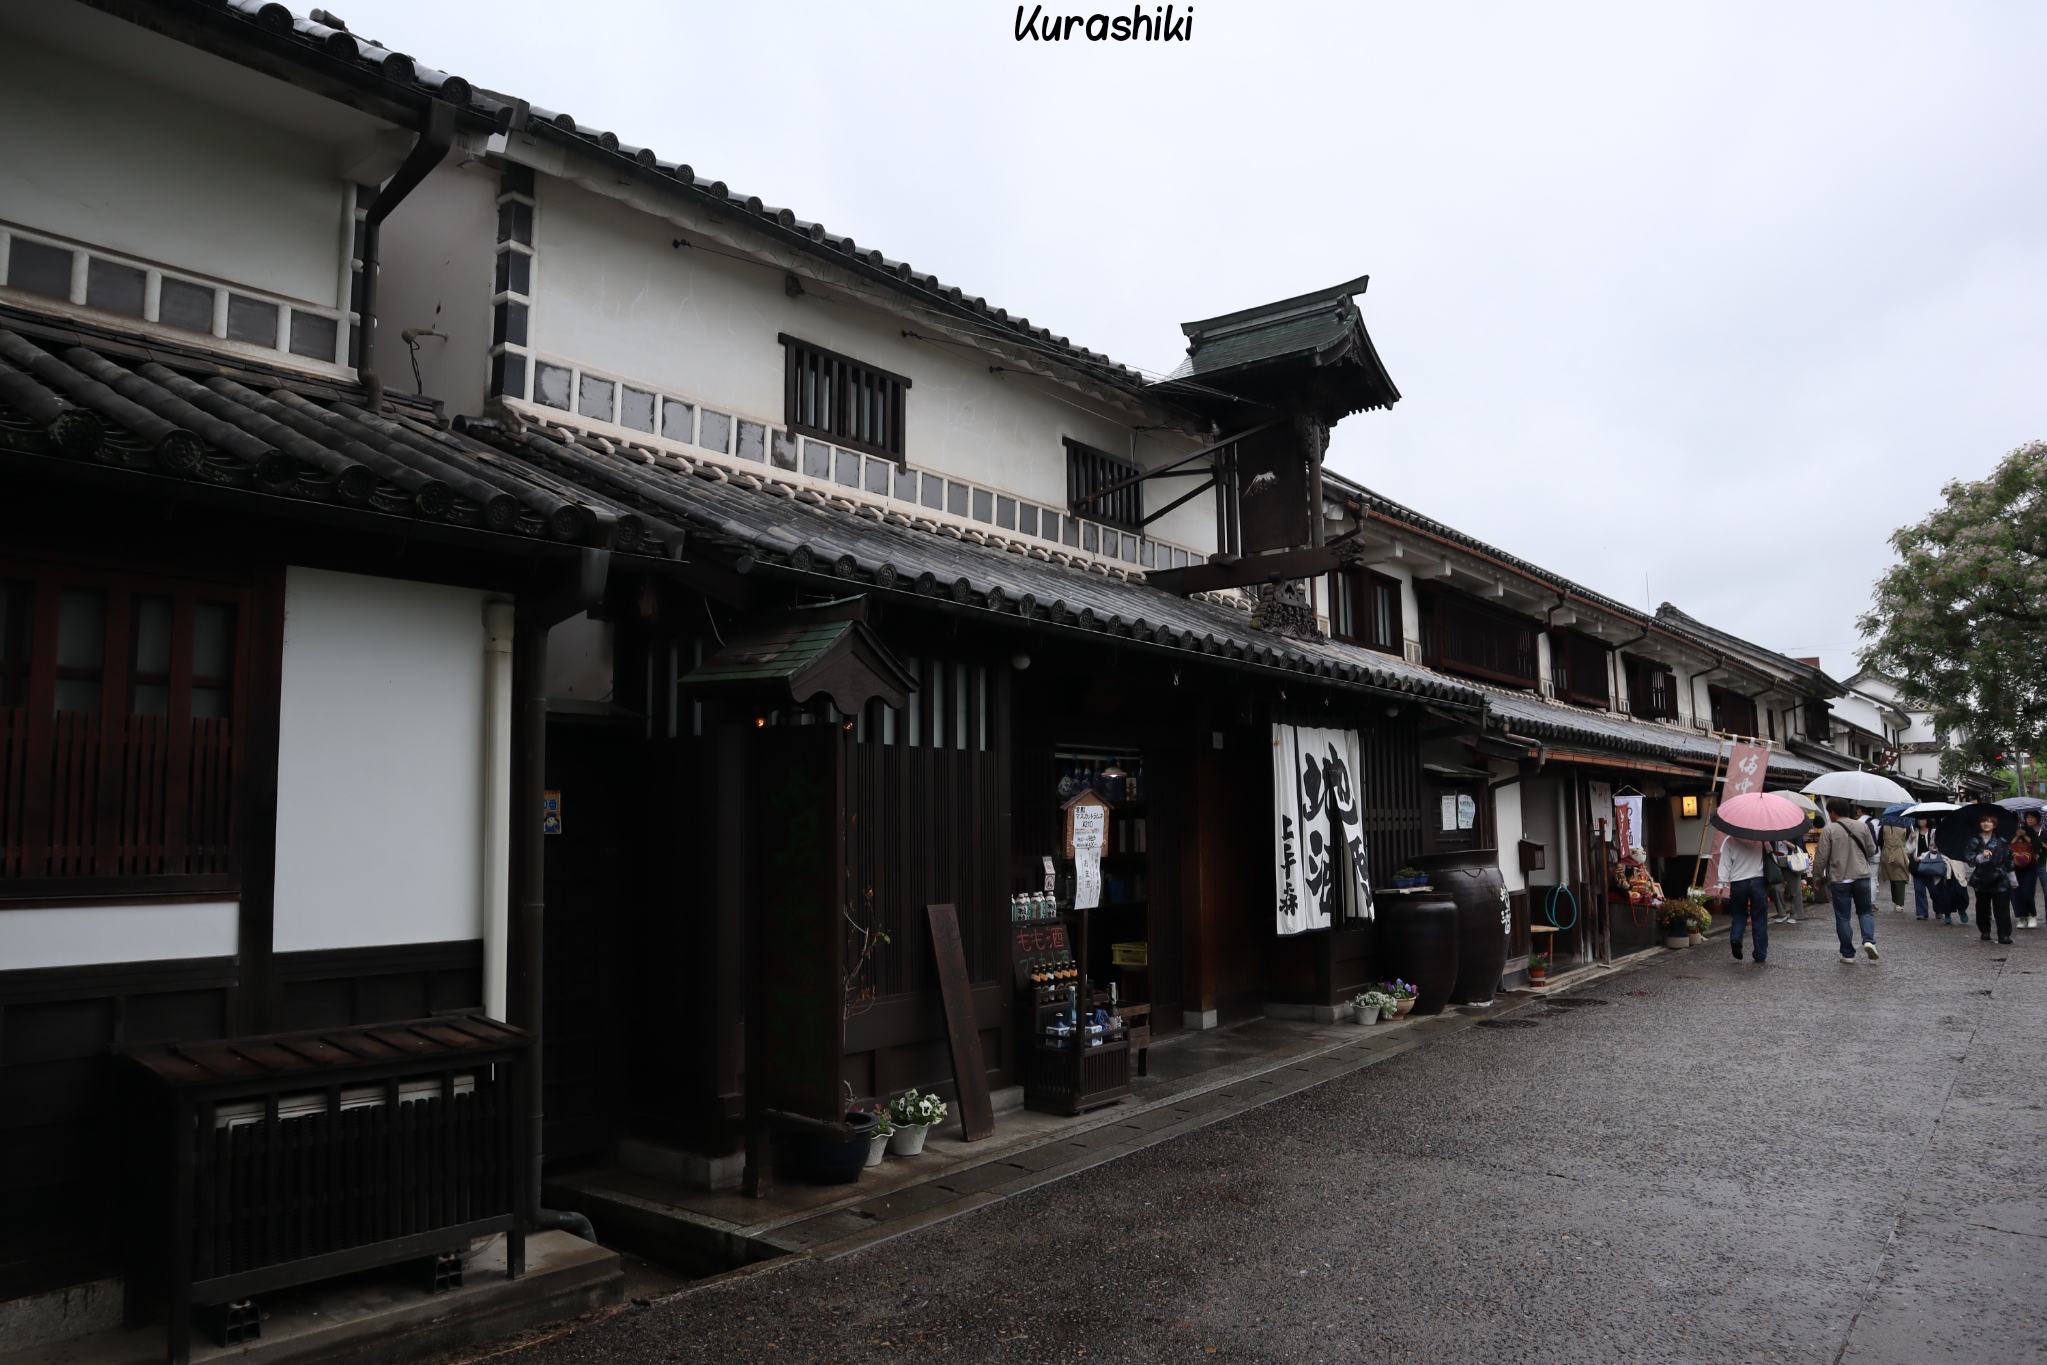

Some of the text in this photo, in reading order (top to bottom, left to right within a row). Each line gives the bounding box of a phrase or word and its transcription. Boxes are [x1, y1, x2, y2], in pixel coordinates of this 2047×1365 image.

[1302, 741, 1375, 922] 地酒
[1016, 926, 1065, 953] もも酒
